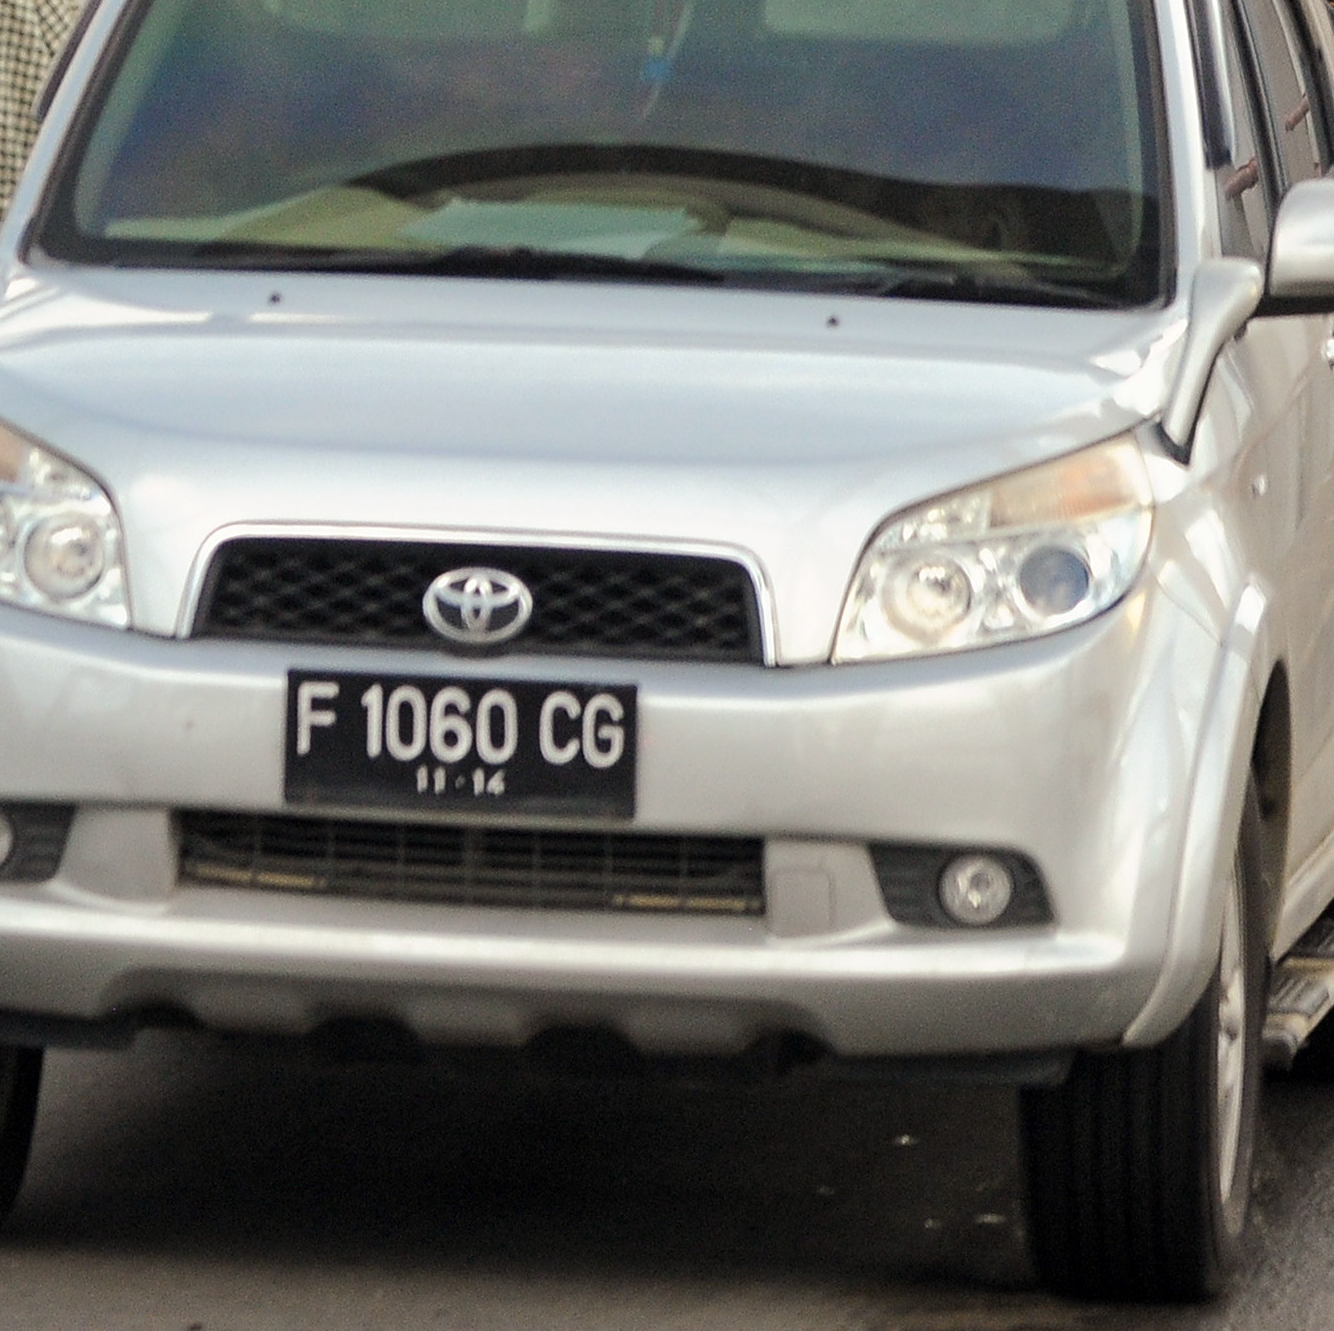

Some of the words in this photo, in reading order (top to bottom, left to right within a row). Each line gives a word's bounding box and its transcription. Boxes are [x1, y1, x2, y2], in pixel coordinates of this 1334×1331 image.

[296, 680, 340, 756] F
[361, 683, 518, 764] 1060
[539, 690, 625, 769] CG
